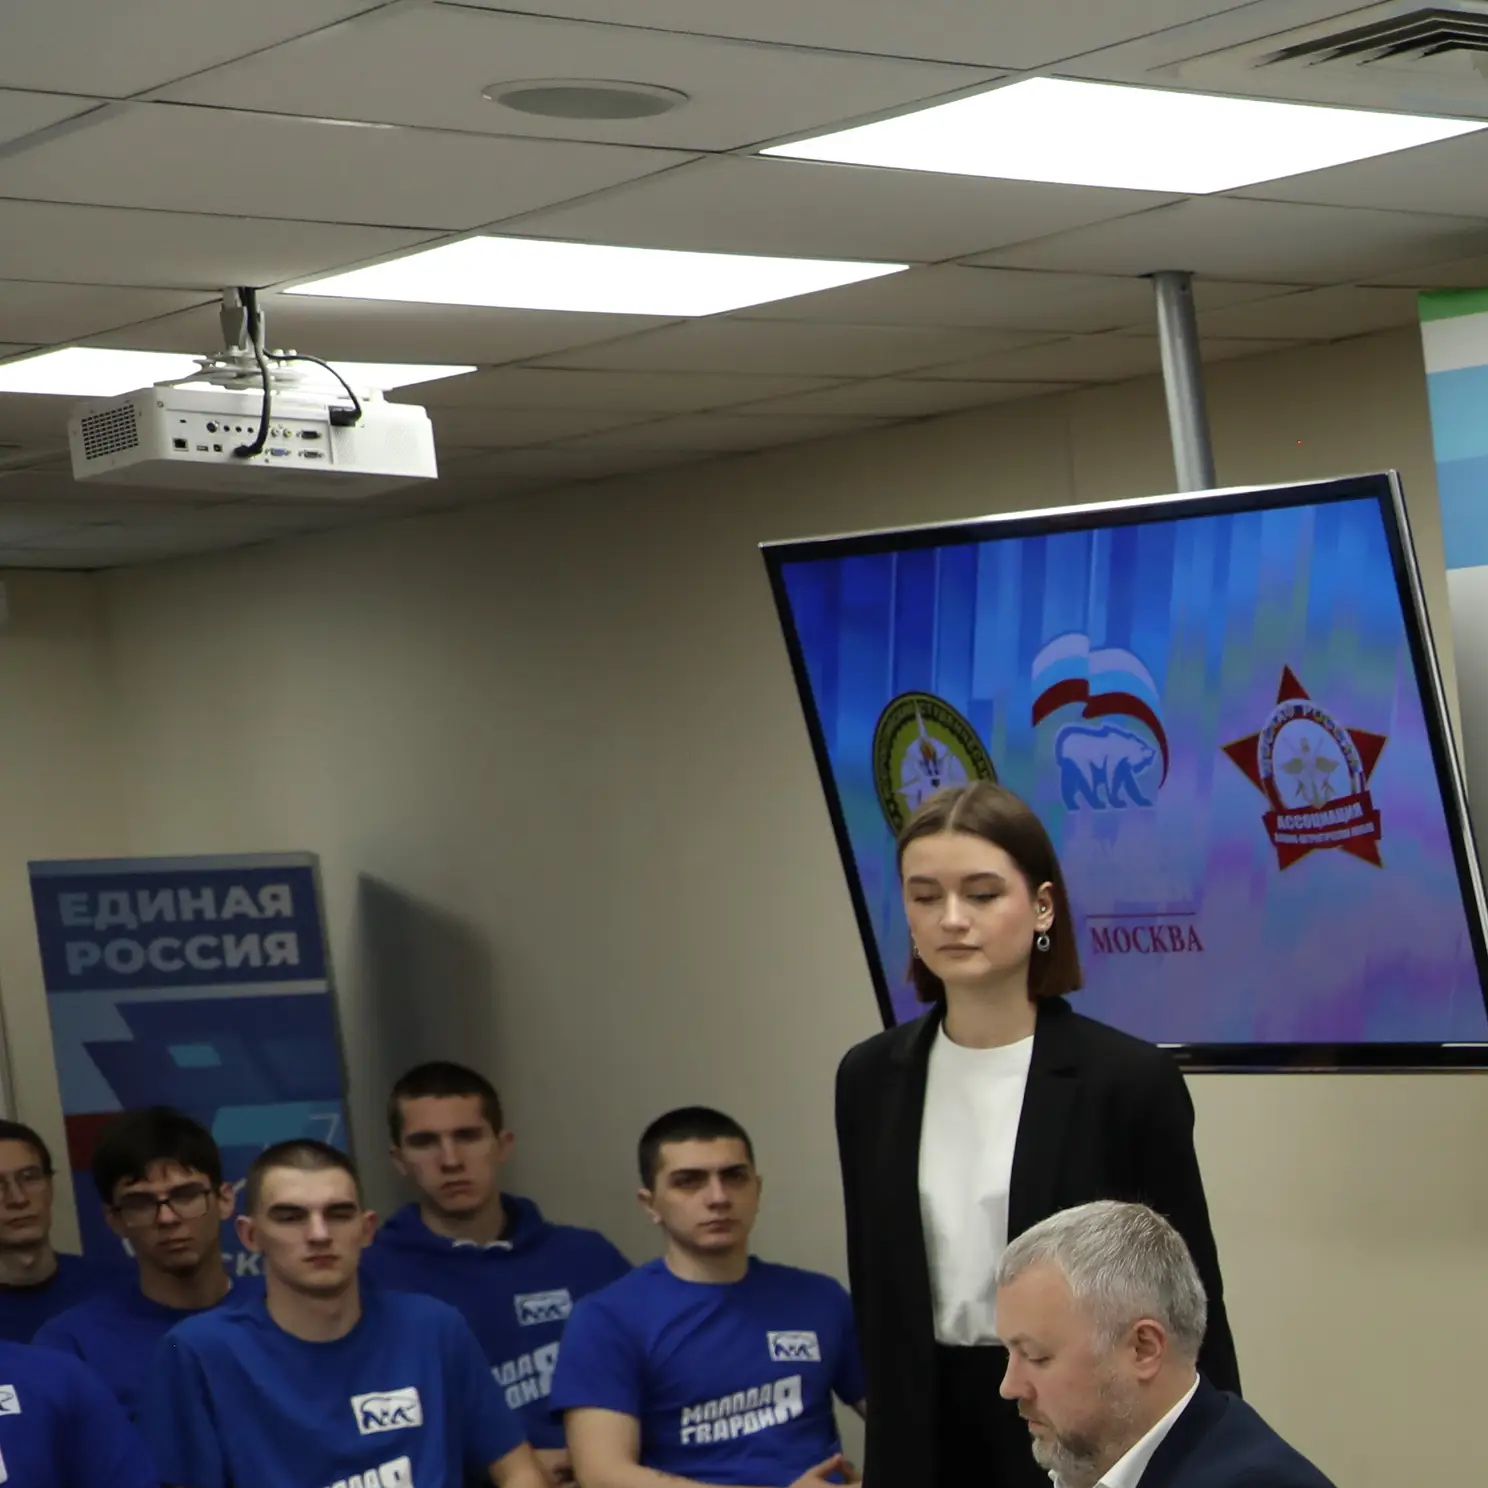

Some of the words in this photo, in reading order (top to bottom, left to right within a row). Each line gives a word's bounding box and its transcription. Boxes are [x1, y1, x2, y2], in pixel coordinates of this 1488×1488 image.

[58, 884, 293, 930] ЕДИНАЯ
[65, 932, 299, 976] РОССИЯ
[1090, 924, 1204, 954] МОСКВА
